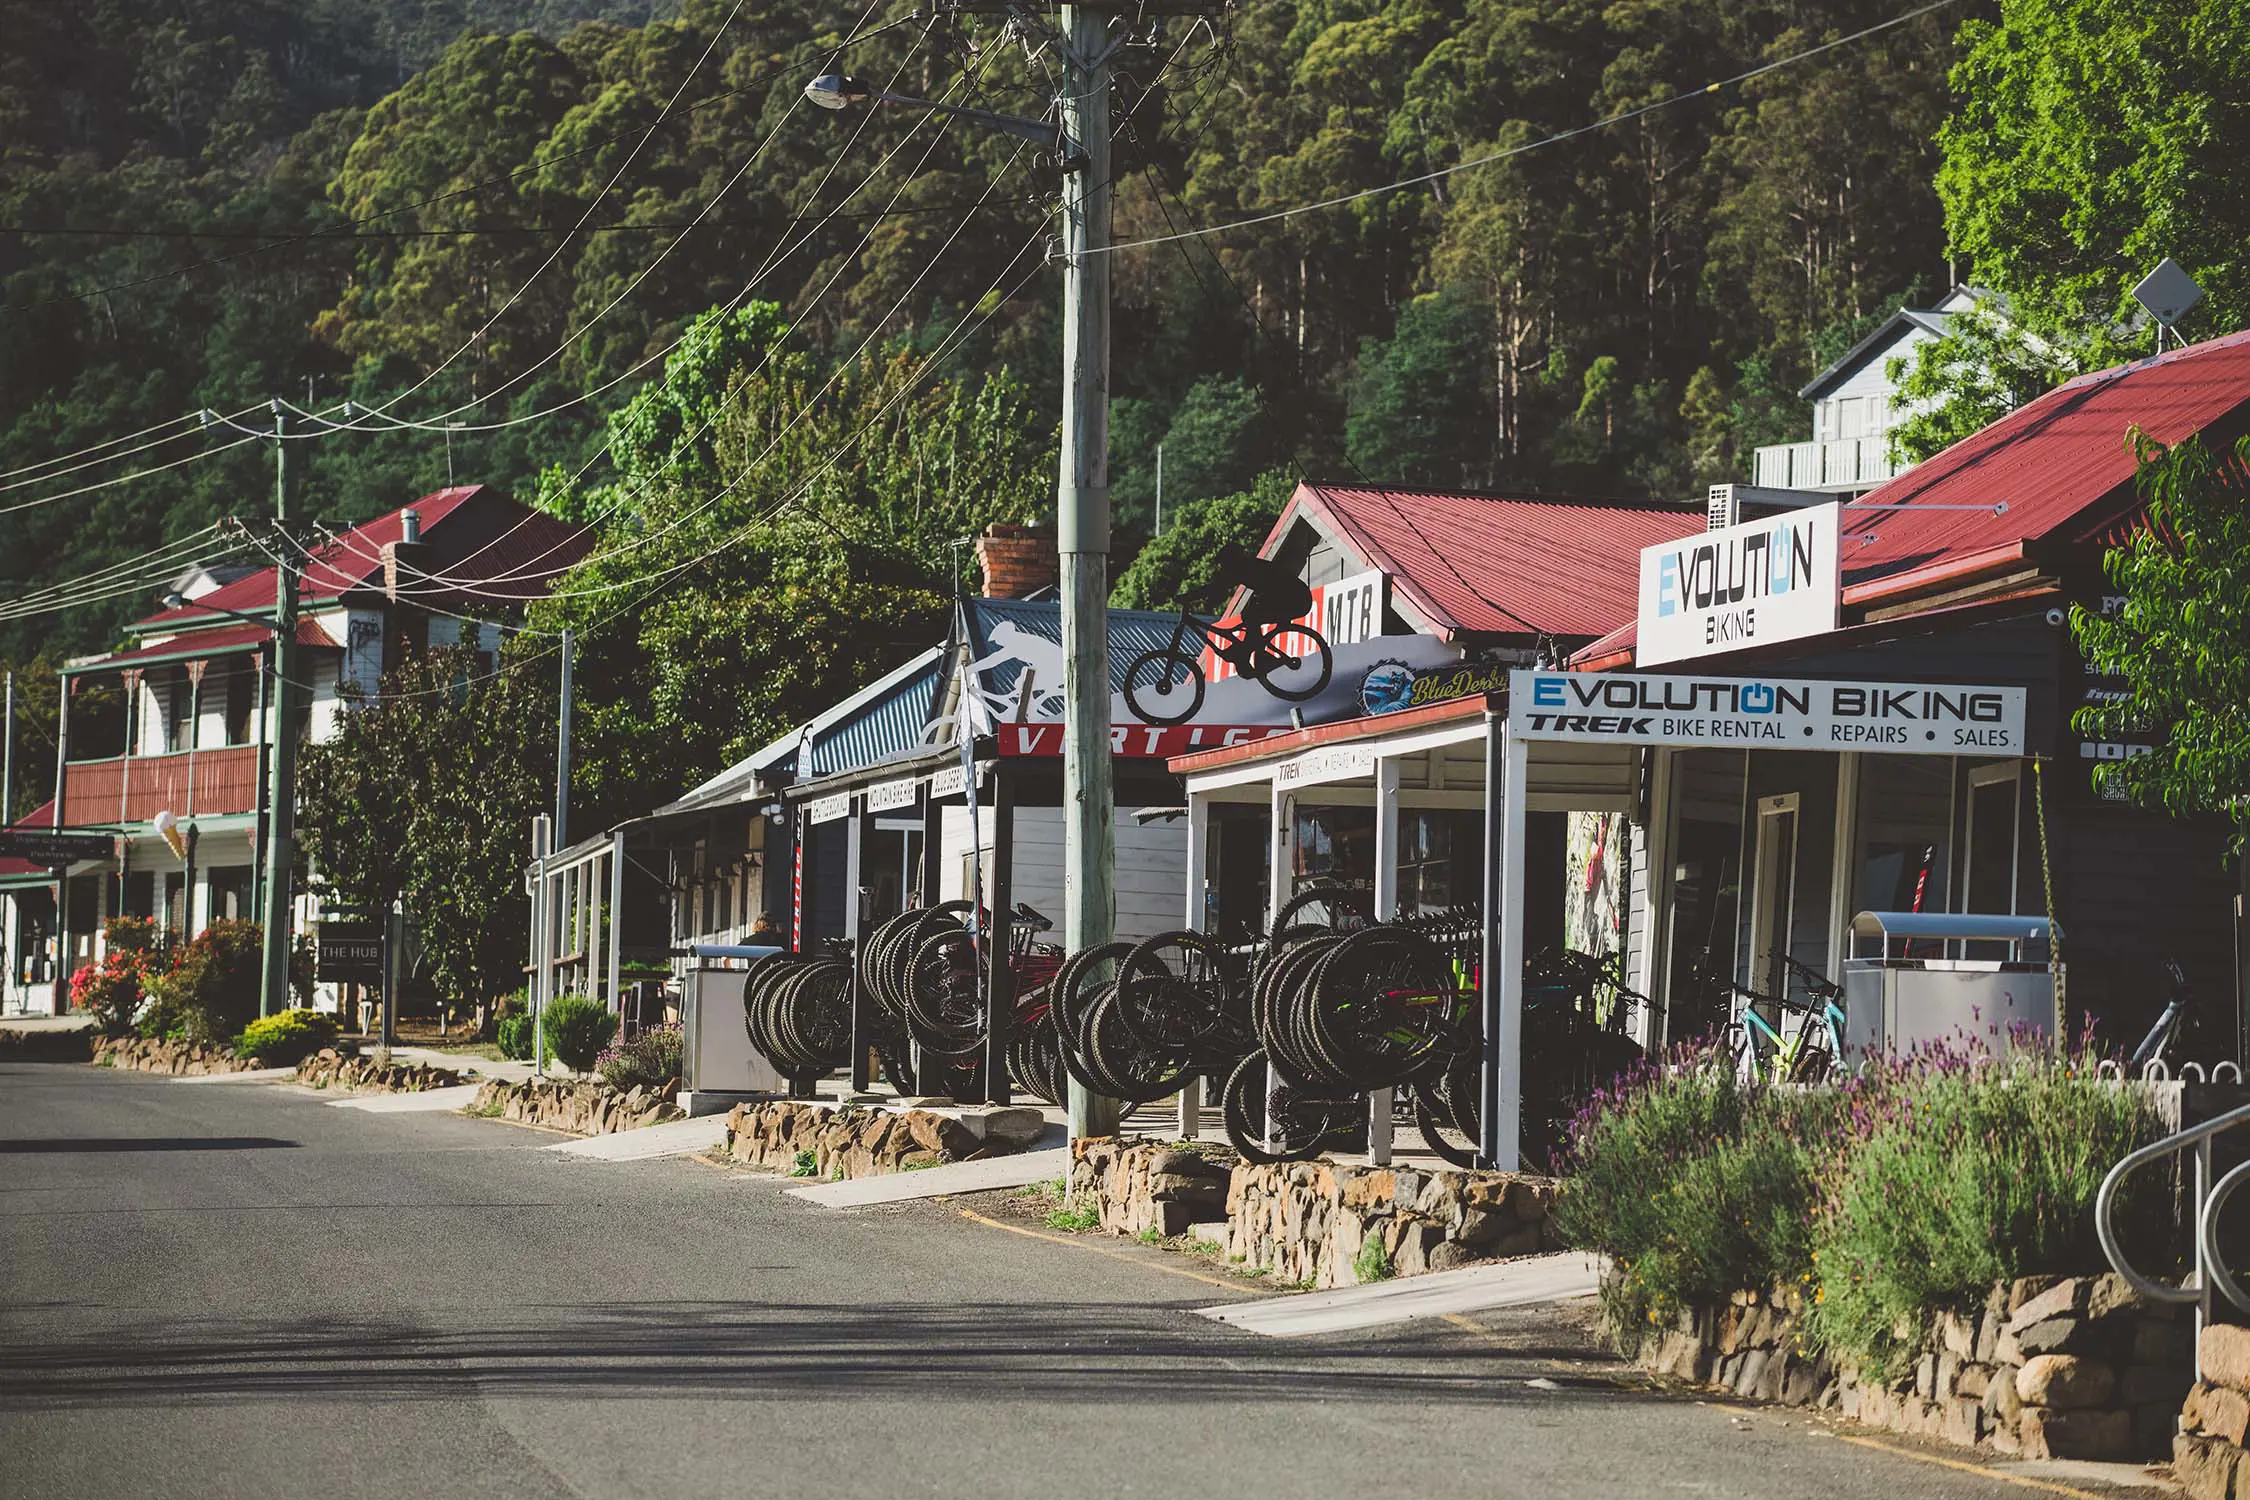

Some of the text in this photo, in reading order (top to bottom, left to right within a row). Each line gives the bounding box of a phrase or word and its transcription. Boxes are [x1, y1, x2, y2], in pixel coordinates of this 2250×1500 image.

[1658, 521, 1813, 618] EVOLUTION
[1327, 584, 1373, 647] MTB
[1706, 608, 1755, 645] BIKING
[1534, 677, 2003, 722] EVOLUTION BIKING
[1525, 713, 2009, 747] TREK BIKE RENTAL REPAIRS SALES
[1279, 762, 1301, 782] TREK
[322, 947, 378, 958] THE HUB
